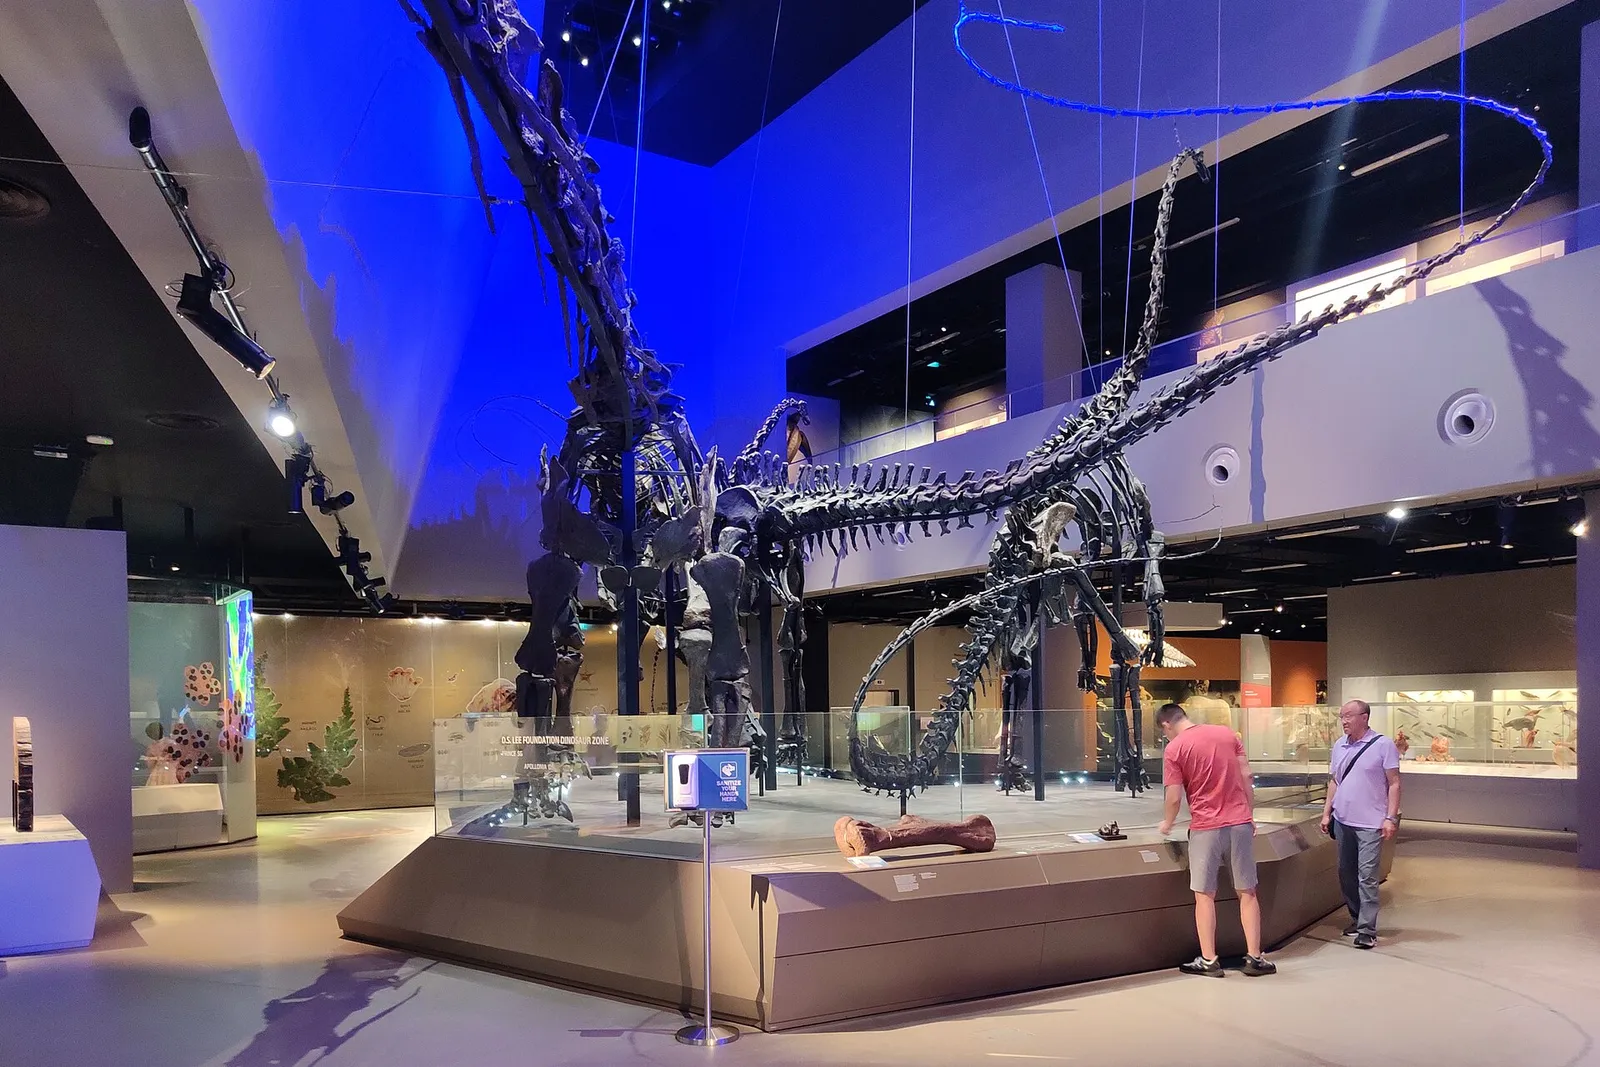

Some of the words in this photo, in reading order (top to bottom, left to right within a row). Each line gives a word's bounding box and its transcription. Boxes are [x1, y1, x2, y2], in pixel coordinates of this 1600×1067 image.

[512, 736, 522, 745] LEE
[523, 736, 560, 745] FOUNDATION
[560, 736, 592, 745] DINOSAUR
[592, 736, 609, 745] ZONE
